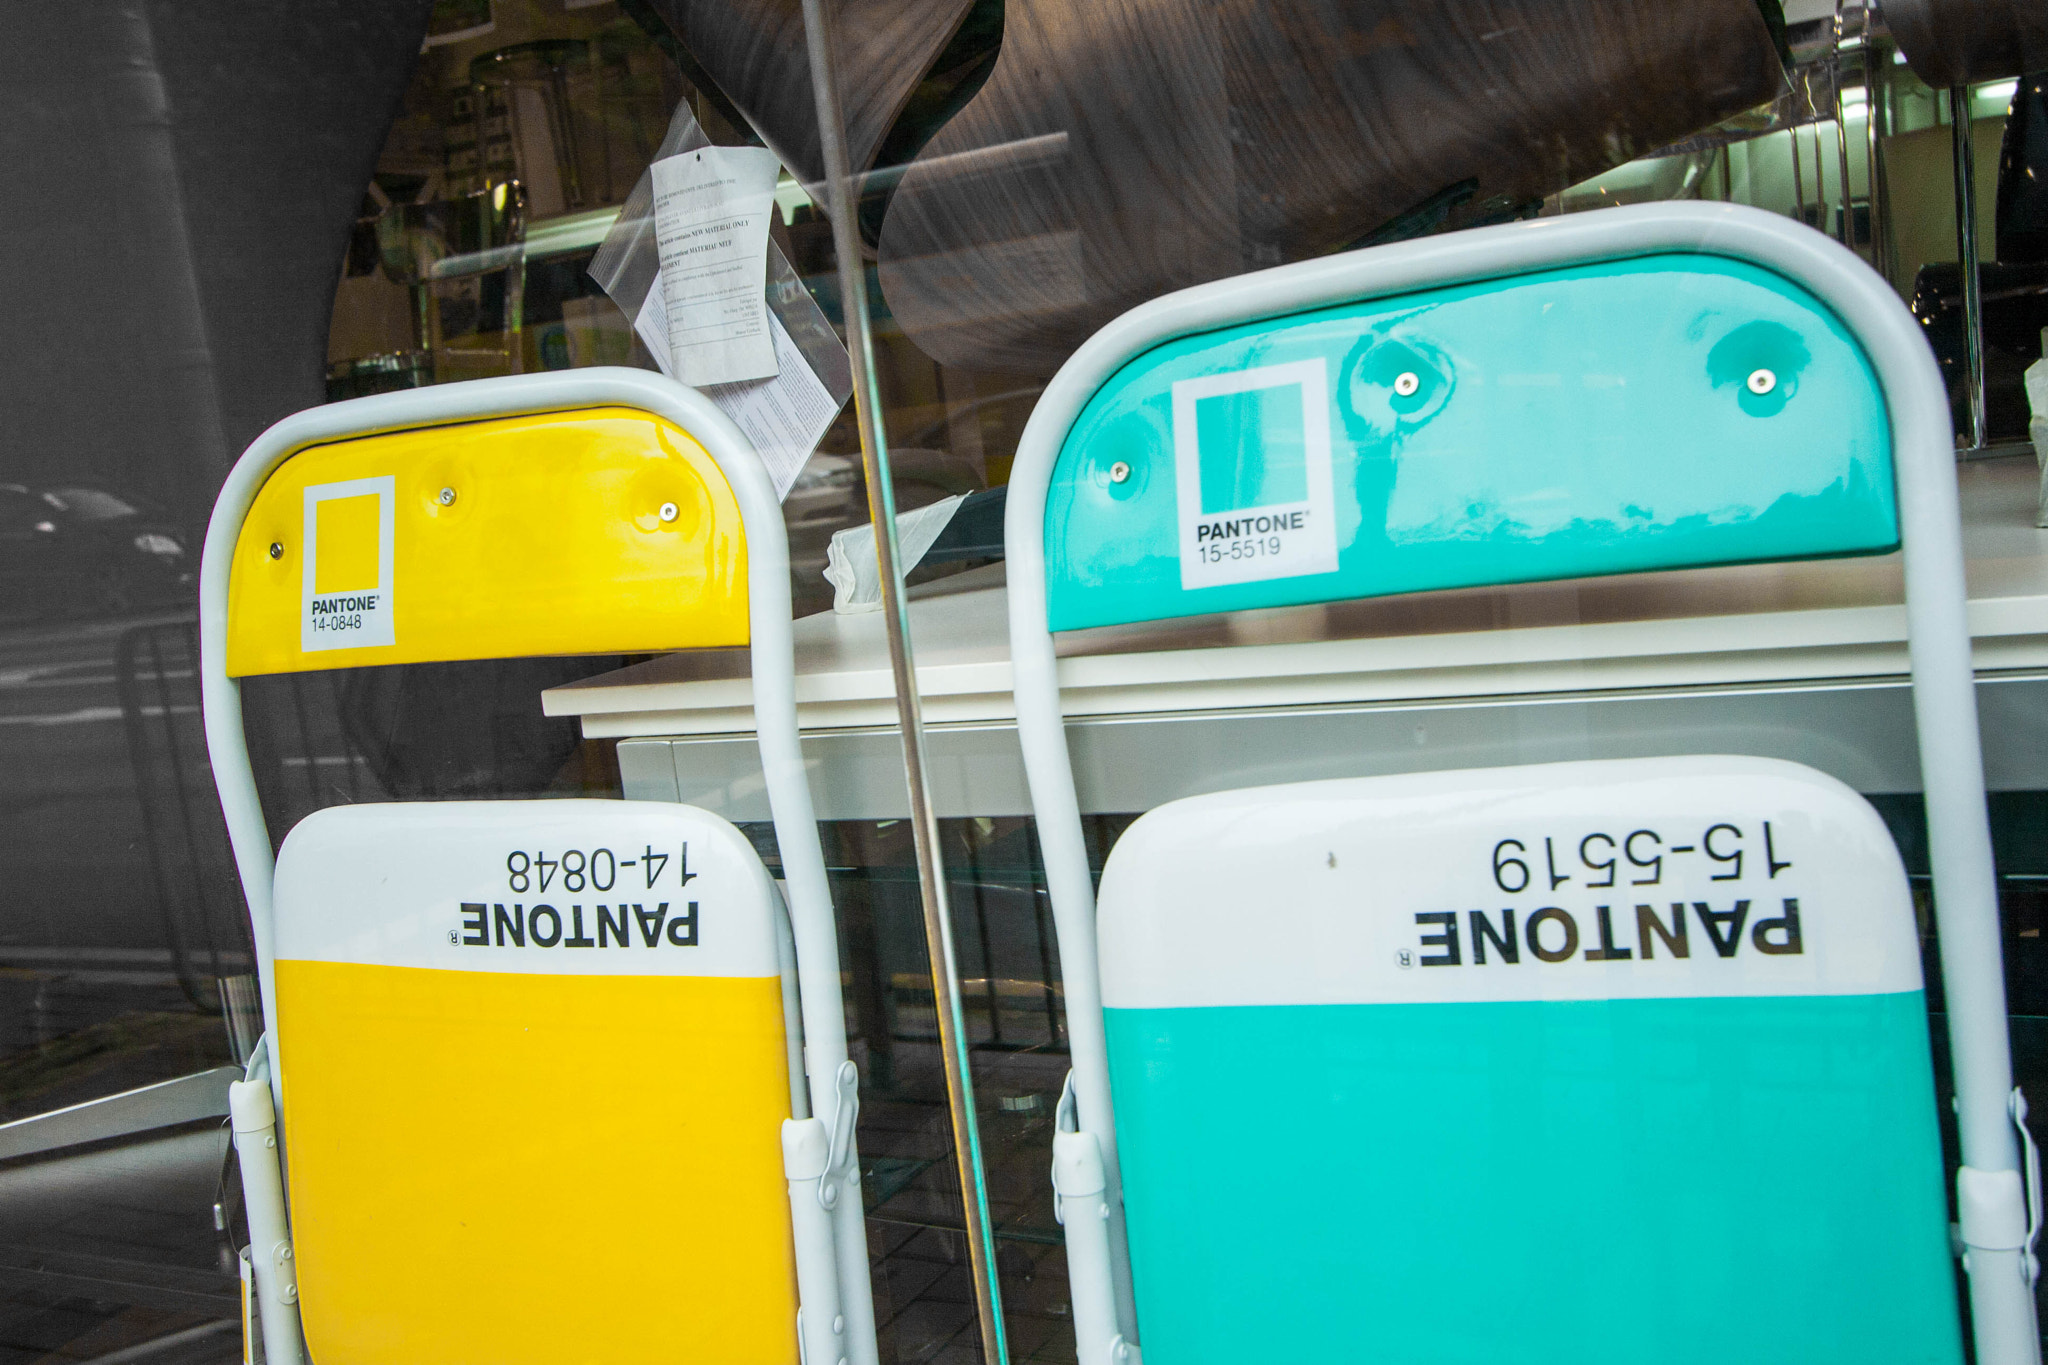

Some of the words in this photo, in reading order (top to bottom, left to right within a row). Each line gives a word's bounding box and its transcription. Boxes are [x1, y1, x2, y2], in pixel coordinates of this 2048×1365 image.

[705, 221, 733, 235] MATERIAL
[732, 219, 750, 229] ONLY
[1197, 511, 1305, 543] PANTONE
[1198, 536, 1281, 564] 15-5519
[312, 596, 376, 615] PANTONE
[312, 614, 362, 632] 14-0848
[507, 841, 697, 893] 14-0848
[1493, 821, 1792, 893] 15-5519
